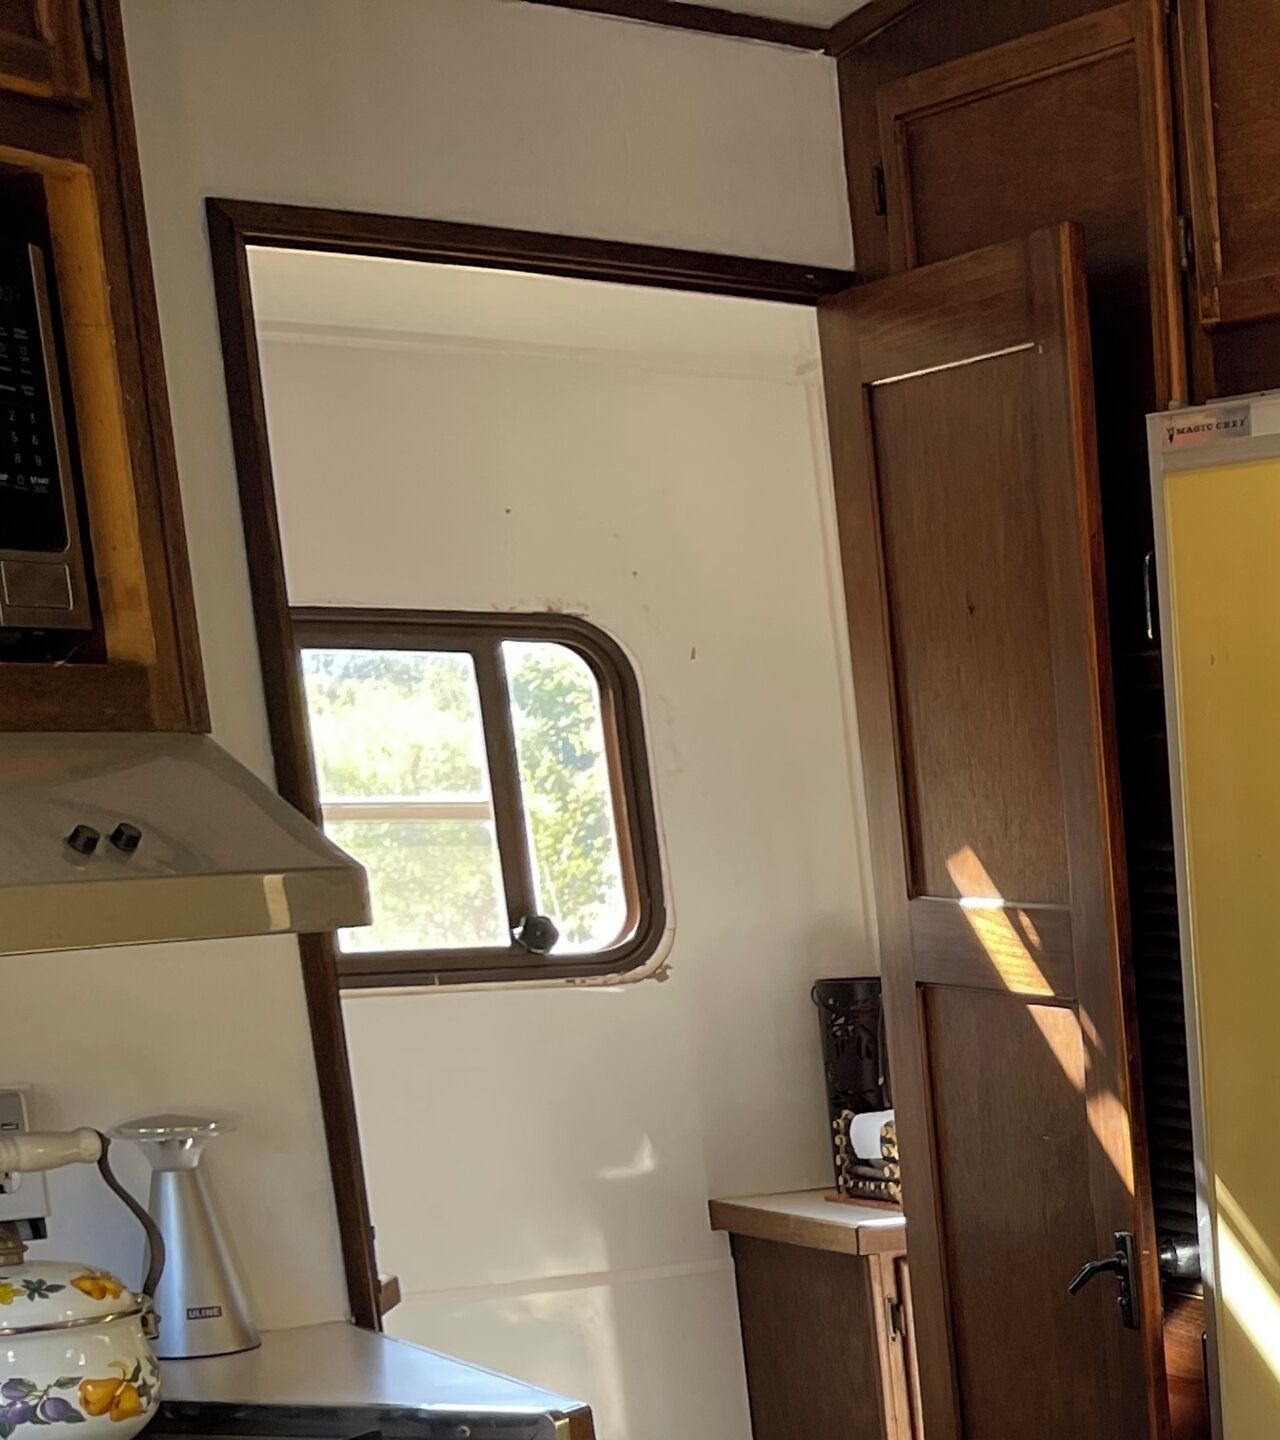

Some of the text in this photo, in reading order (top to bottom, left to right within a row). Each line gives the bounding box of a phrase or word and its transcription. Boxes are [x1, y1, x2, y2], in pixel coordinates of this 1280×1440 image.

[1176, 417, 1247, 435] MAGIC CHEF
[189, 1308, 220, 1318] ULINE
